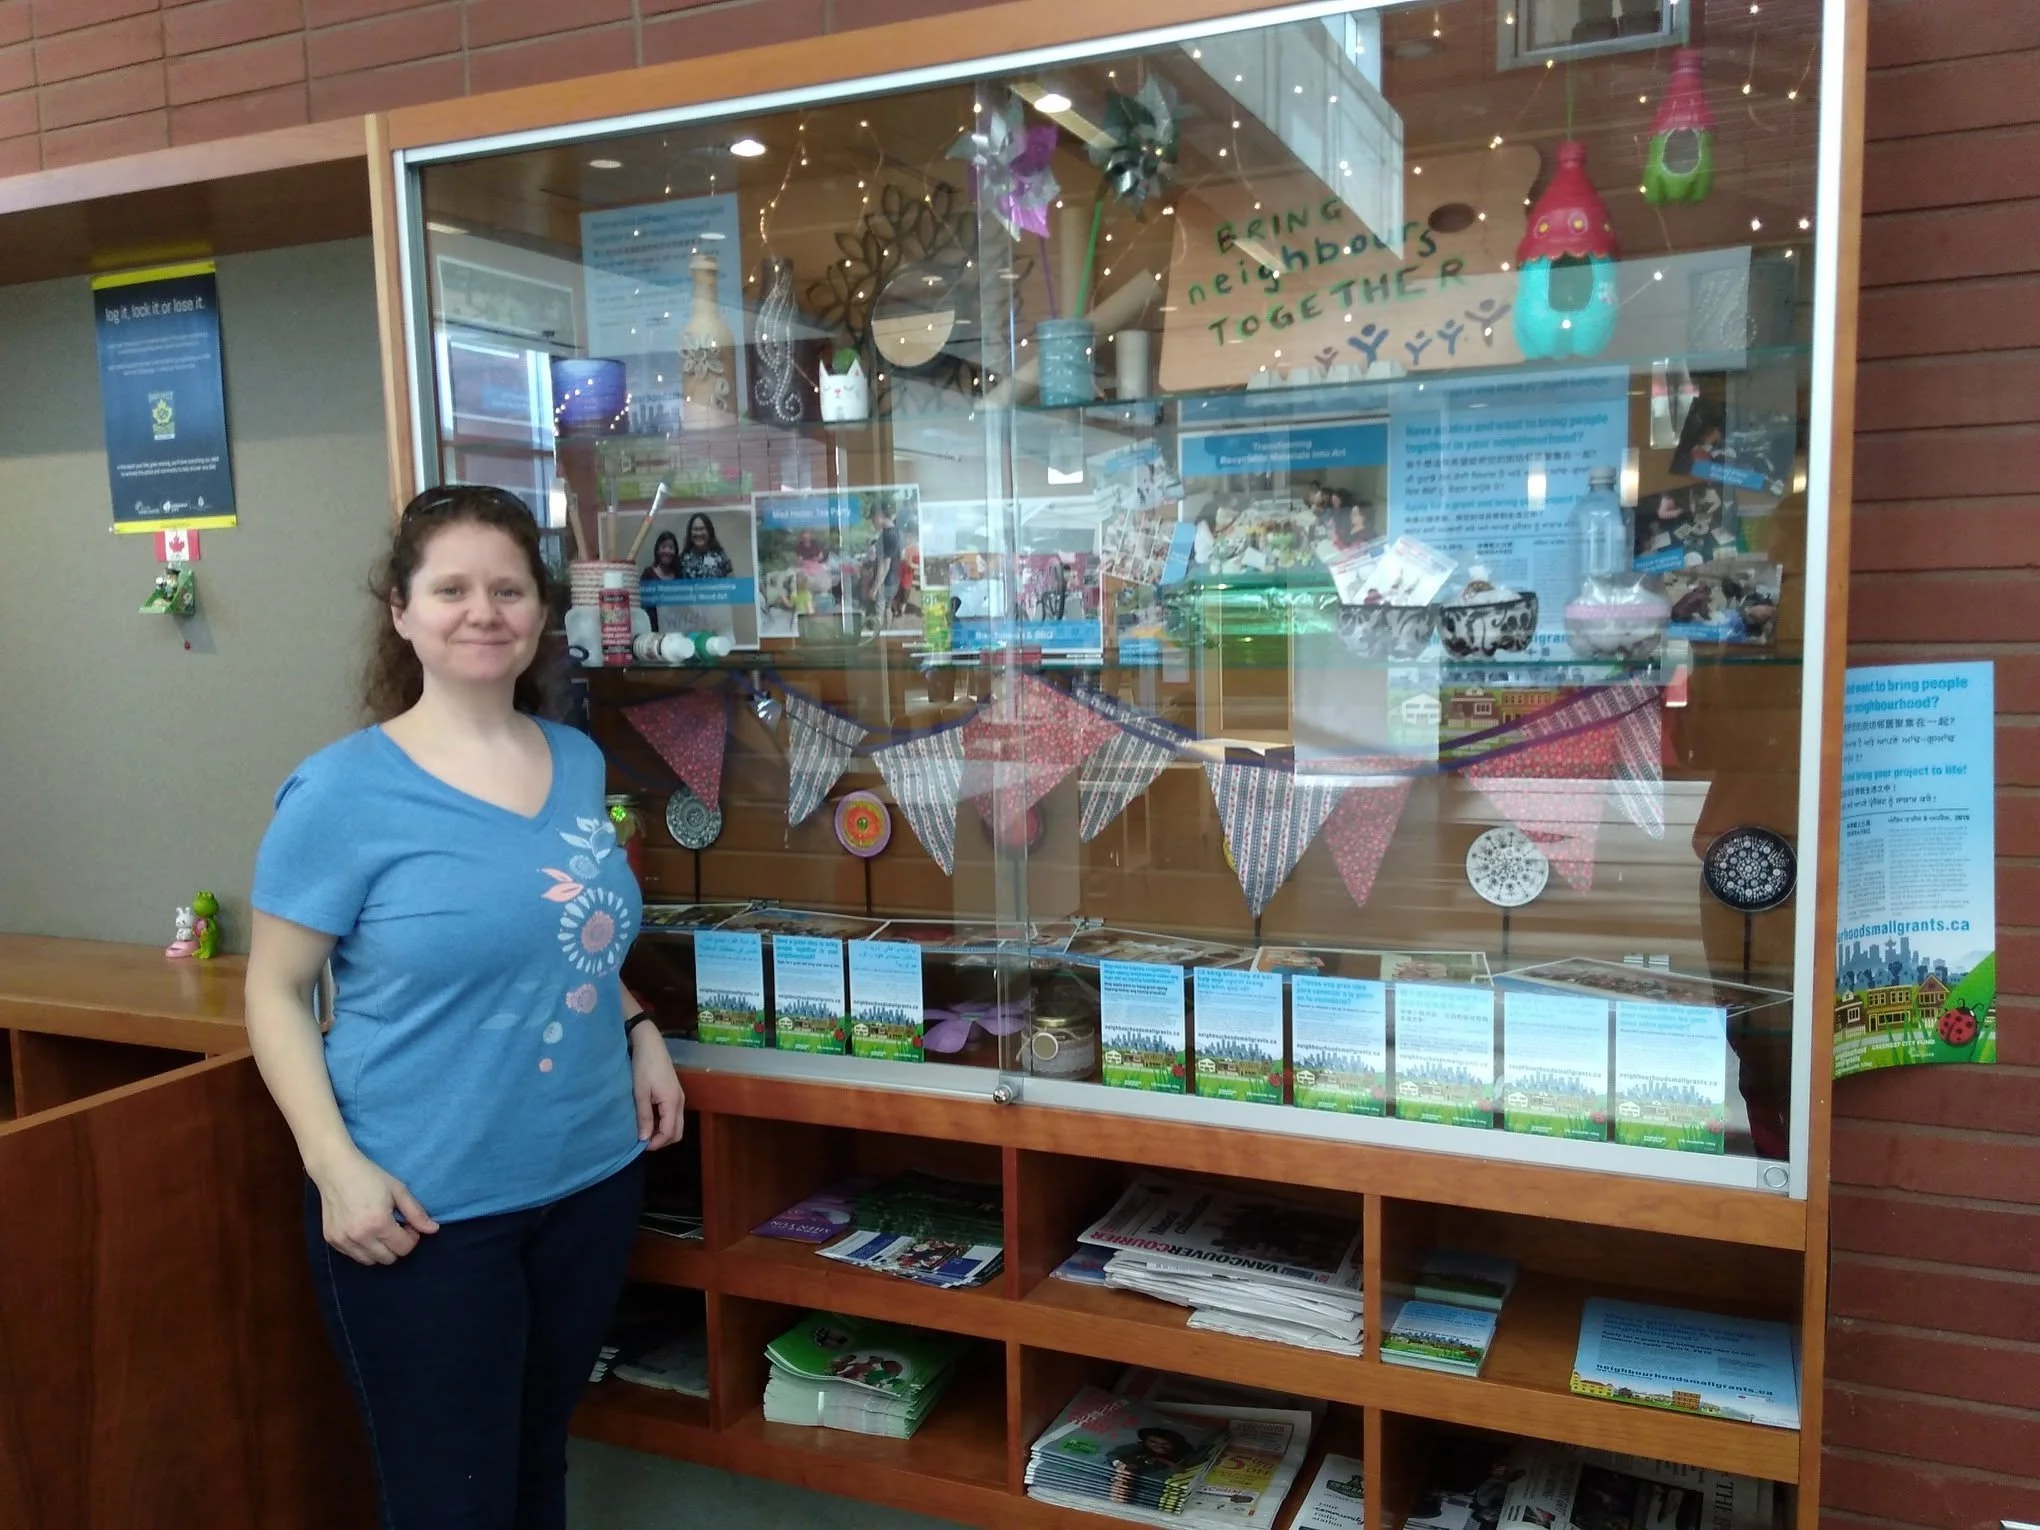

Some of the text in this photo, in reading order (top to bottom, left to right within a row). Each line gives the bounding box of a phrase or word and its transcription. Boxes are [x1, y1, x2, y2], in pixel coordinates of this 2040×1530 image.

[1218, 200, 1341, 254] BRING
[1188, 222, 1438, 305] neighbours
[105, 308, 120, 324] log
[131, 302, 151, 318] lock
[152, 301, 161, 315] it
[161, 302, 172, 314] or
[173, 298, 194, 313] lose
[195, 296, 205, 310] it.
[1209, 258, 1464, 346] TOGETHER
[1876, 680, 1886, 692] to
[1887, 679, 1920, 692] bring
[1922, 676, 1968, 692] people
[1894, 765, 1928, 779] project
[1932, 765, 1943, 775] to
[1596, 1362, 1775, 1397] neighbourhoodsmallgrants.ca
